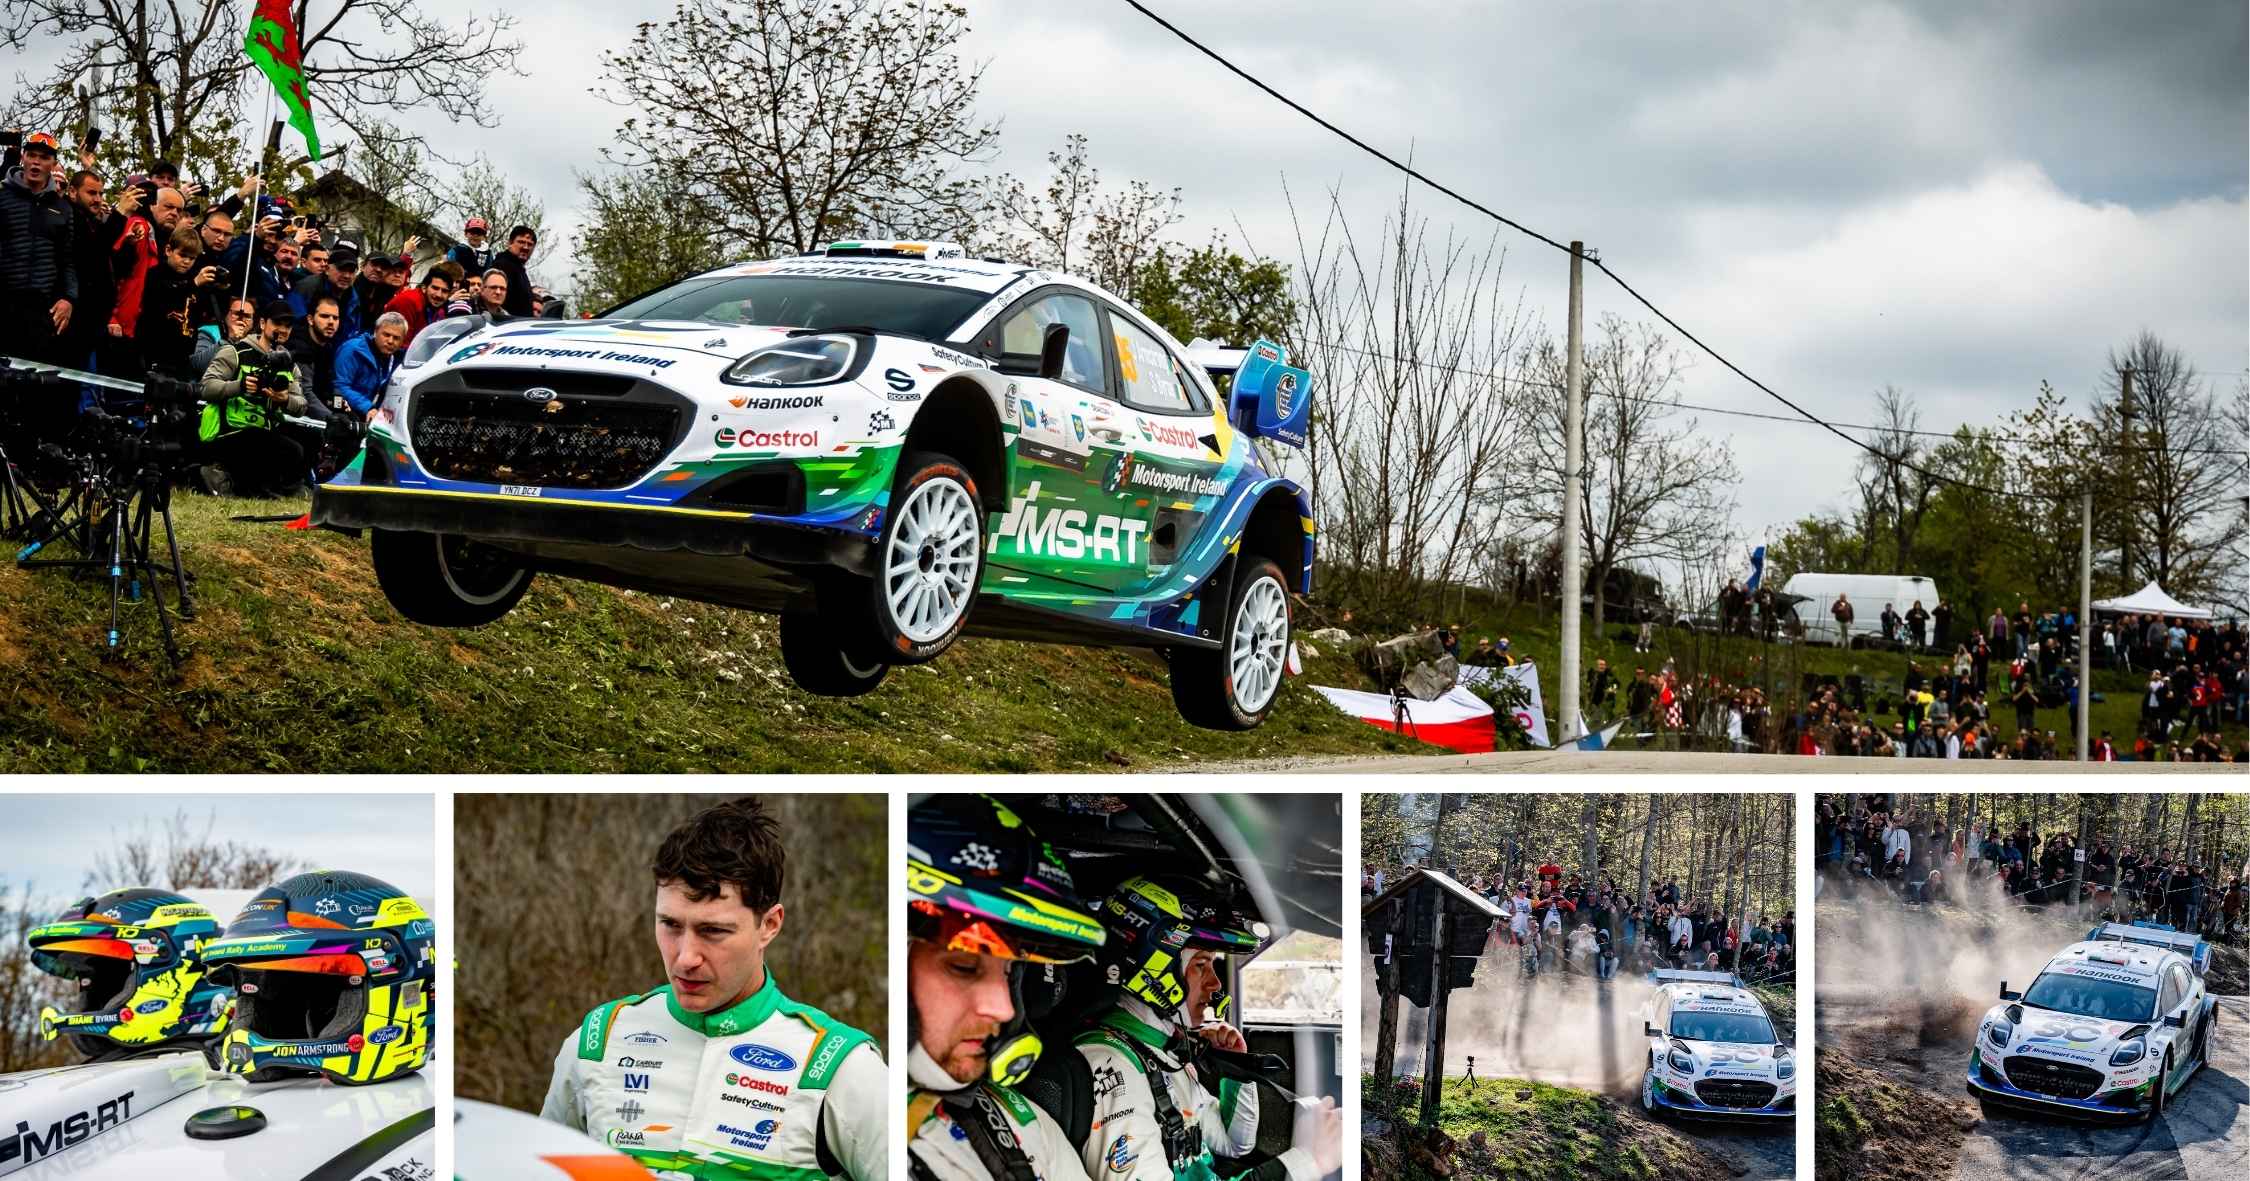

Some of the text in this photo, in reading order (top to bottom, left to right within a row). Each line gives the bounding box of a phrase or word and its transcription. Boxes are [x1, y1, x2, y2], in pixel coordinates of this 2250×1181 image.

[493, 344, 678, 369] Motorsport Ireland
[739, 429, 819, 448] Castrol
[1150, 420, 1199, 450] Castrol
[1131, 463, 1227, 497] Motorsport Ireland
[1016, 505, 1148, 564] MS-RT
[247, 942, 288, 954] Academy
[371, 958, 388, 967] BELL
[68, 1013, 119, 1025] SHANE BYRNE
[375, 1030, 399, 1043] Ford
[273, 1043, 350, 1057] JON ARMSTRONG
[743, 1047, 784, 1068] Ford
[809, 1035, 845, 1080] sparco
[624, 1073, 649, 1090] LVI
[740, 1076, 788, 1097] Castrol
[720, 1093, 786, 1113] SafetyCulture
[22, 1090, 134, 1165] MS-RT
[716, 1124, 772, 1143] Motorsport
[730, 1136, 768, 1151] Ireland
